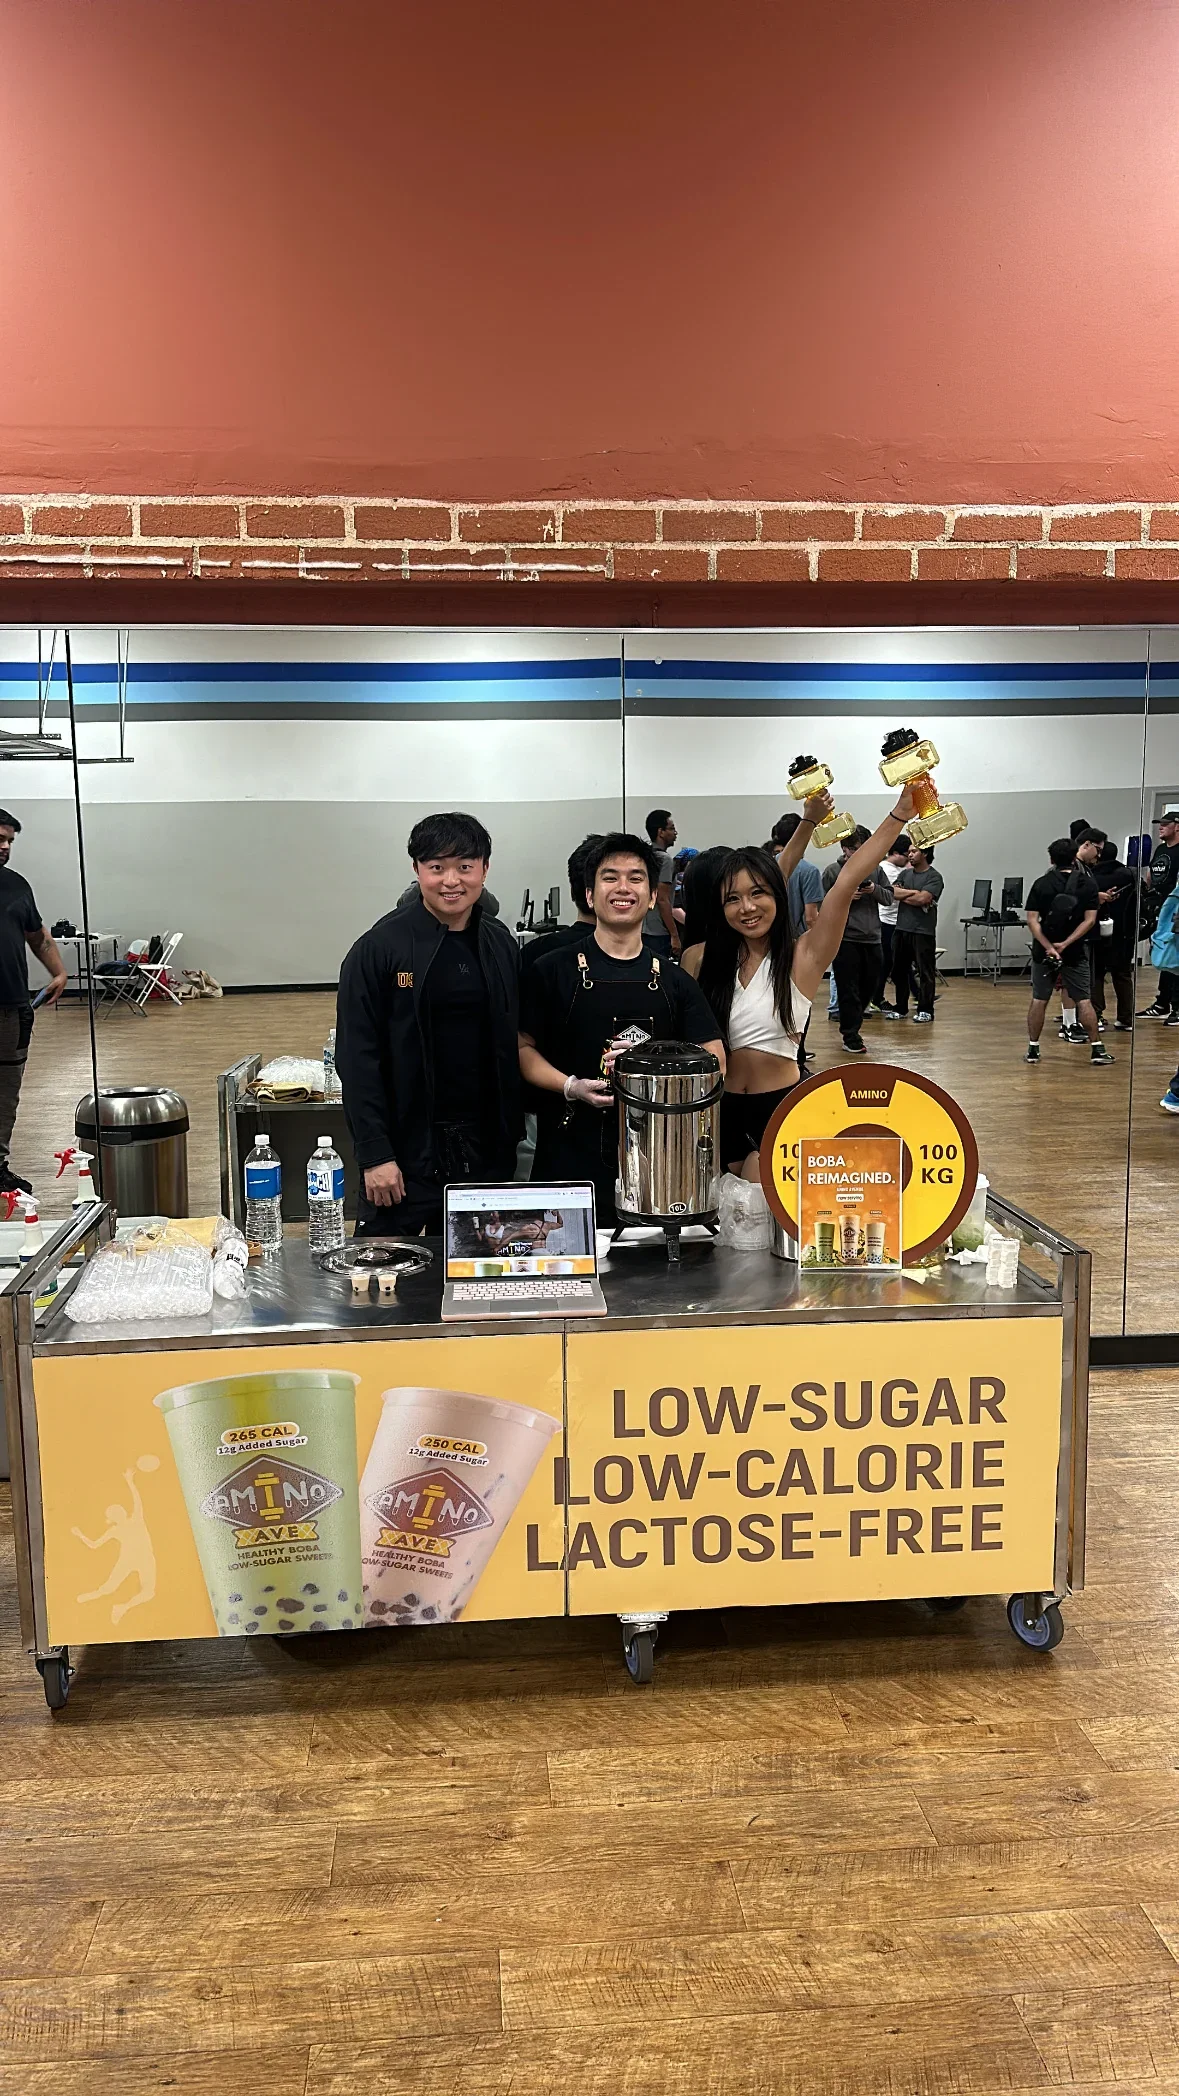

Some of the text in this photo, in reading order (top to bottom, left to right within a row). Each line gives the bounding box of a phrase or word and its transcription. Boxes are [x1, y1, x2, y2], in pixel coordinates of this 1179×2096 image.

[849, 1089, 889, 1100] AMINO
[919, 1144, 958, 1161] 100
[807, 1155, 846, 1168] BOBA
[782, 1166, 799, 1182] K
[807, 1171, 896, 1185] REIMAGINED.
[921, 1167, 954, 1184] KG
[613, 1376, 1008, 1439] LOW-SUGAR
[229, 1426, 293, 1443] 265 CAL
[218, 1437, 306, 1455] 12g Added Sugar
[423, 1437, 480, 1454] 250 CAL
[408, 1448, 488, 1466] 12g Added Sugar
[553, 1440, 1005, 1505] LOW-CALORIE
[255, 1525, 299, 1543] AVE
[394, 1534, 437, 1550] AVE
[526, 1503, 1004, 1571] LACTOSE-FREE
[237, 1544, 320, 1561] HEALTHY BOBA
[371, 1549, 445, 1569] HEALTHY BOBA
[418, 1566, 454, 1580] SWEETS
